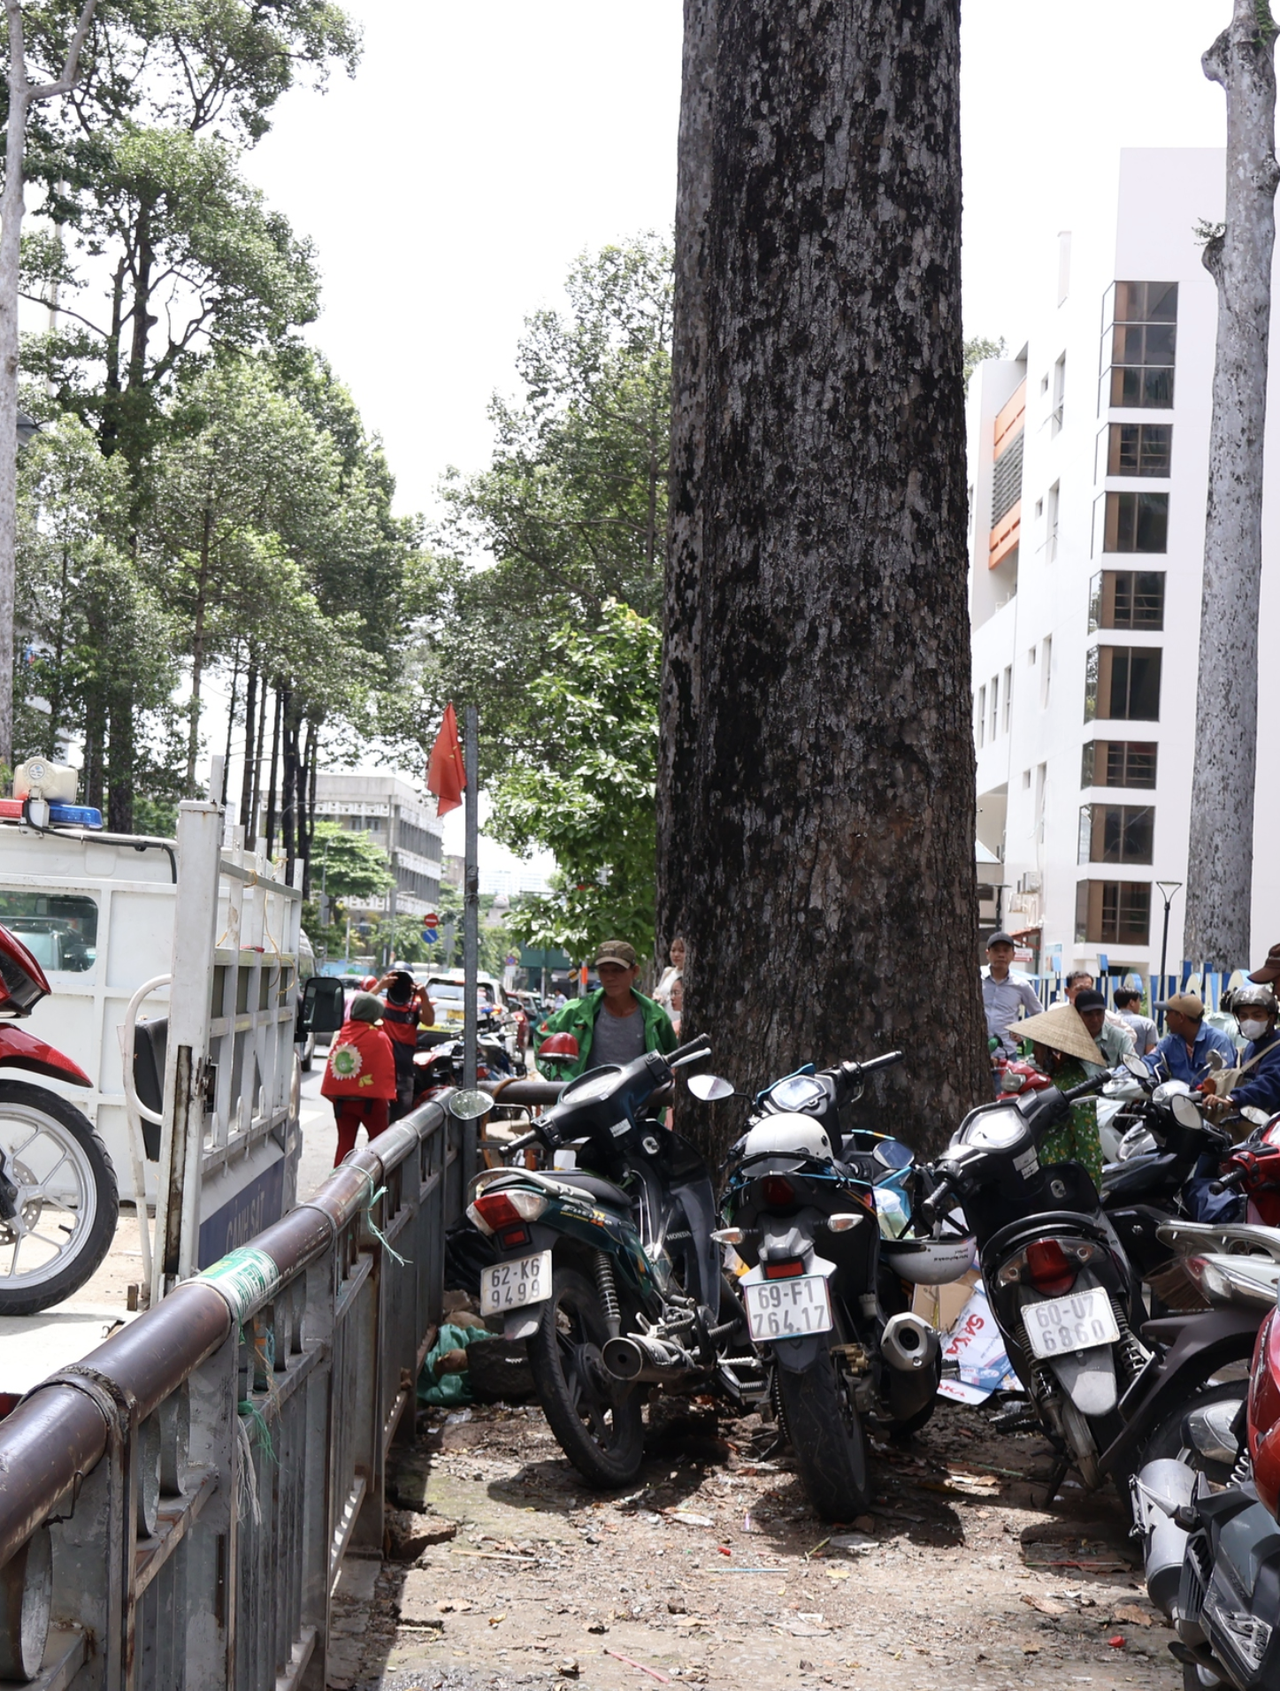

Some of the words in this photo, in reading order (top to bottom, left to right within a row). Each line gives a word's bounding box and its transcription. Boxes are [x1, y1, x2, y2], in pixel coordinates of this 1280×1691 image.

[666, 1230, 692, 1242] HONDA
[491, 1257, 540, 1288] 62-K6
[757, 1279, 814, 1310] 69-F1
[752, 1304, 825, 1337] 764.17
[1035, 1294, 1094, 1328] 60-U7
[1042, 1319, 1106, 1352] 6860
